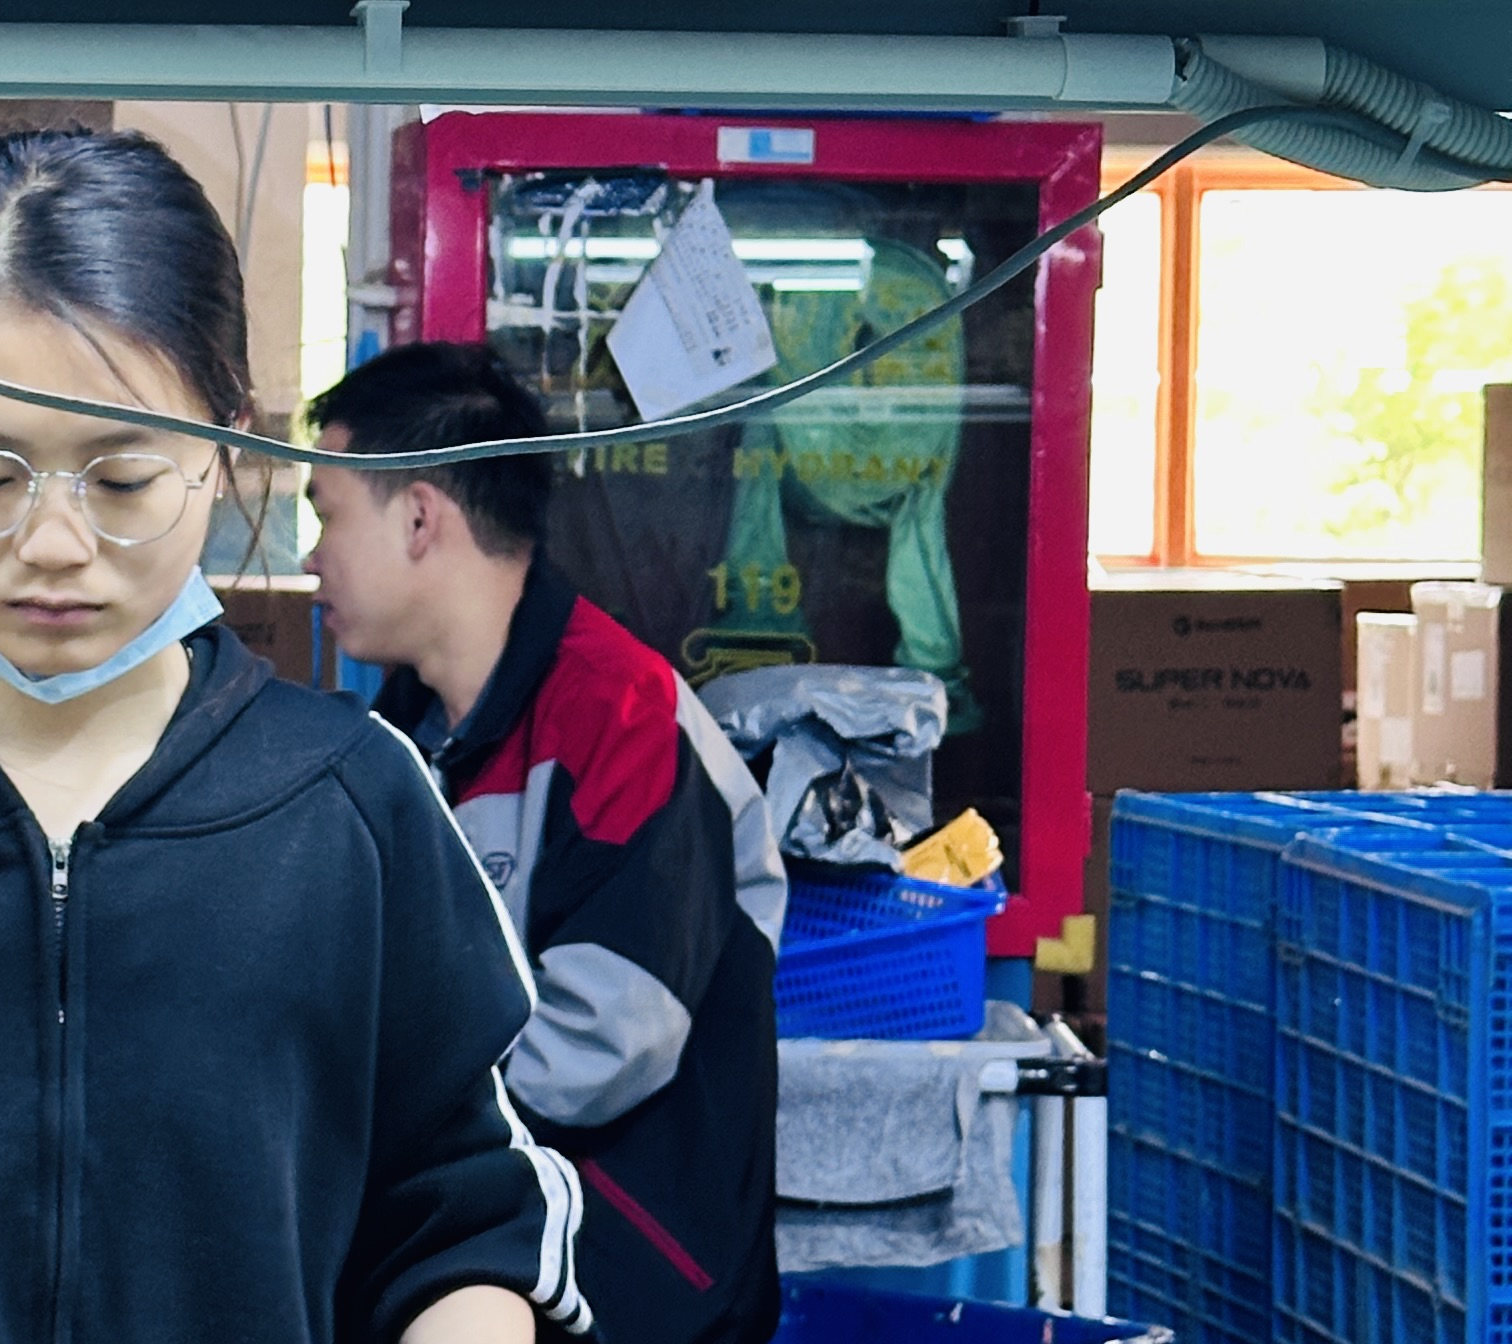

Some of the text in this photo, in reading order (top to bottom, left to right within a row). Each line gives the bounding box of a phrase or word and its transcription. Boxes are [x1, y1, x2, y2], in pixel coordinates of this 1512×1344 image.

[707, 561, 803, 615] 119
[1115, 667, 1312, 692] SUPER NOVA
